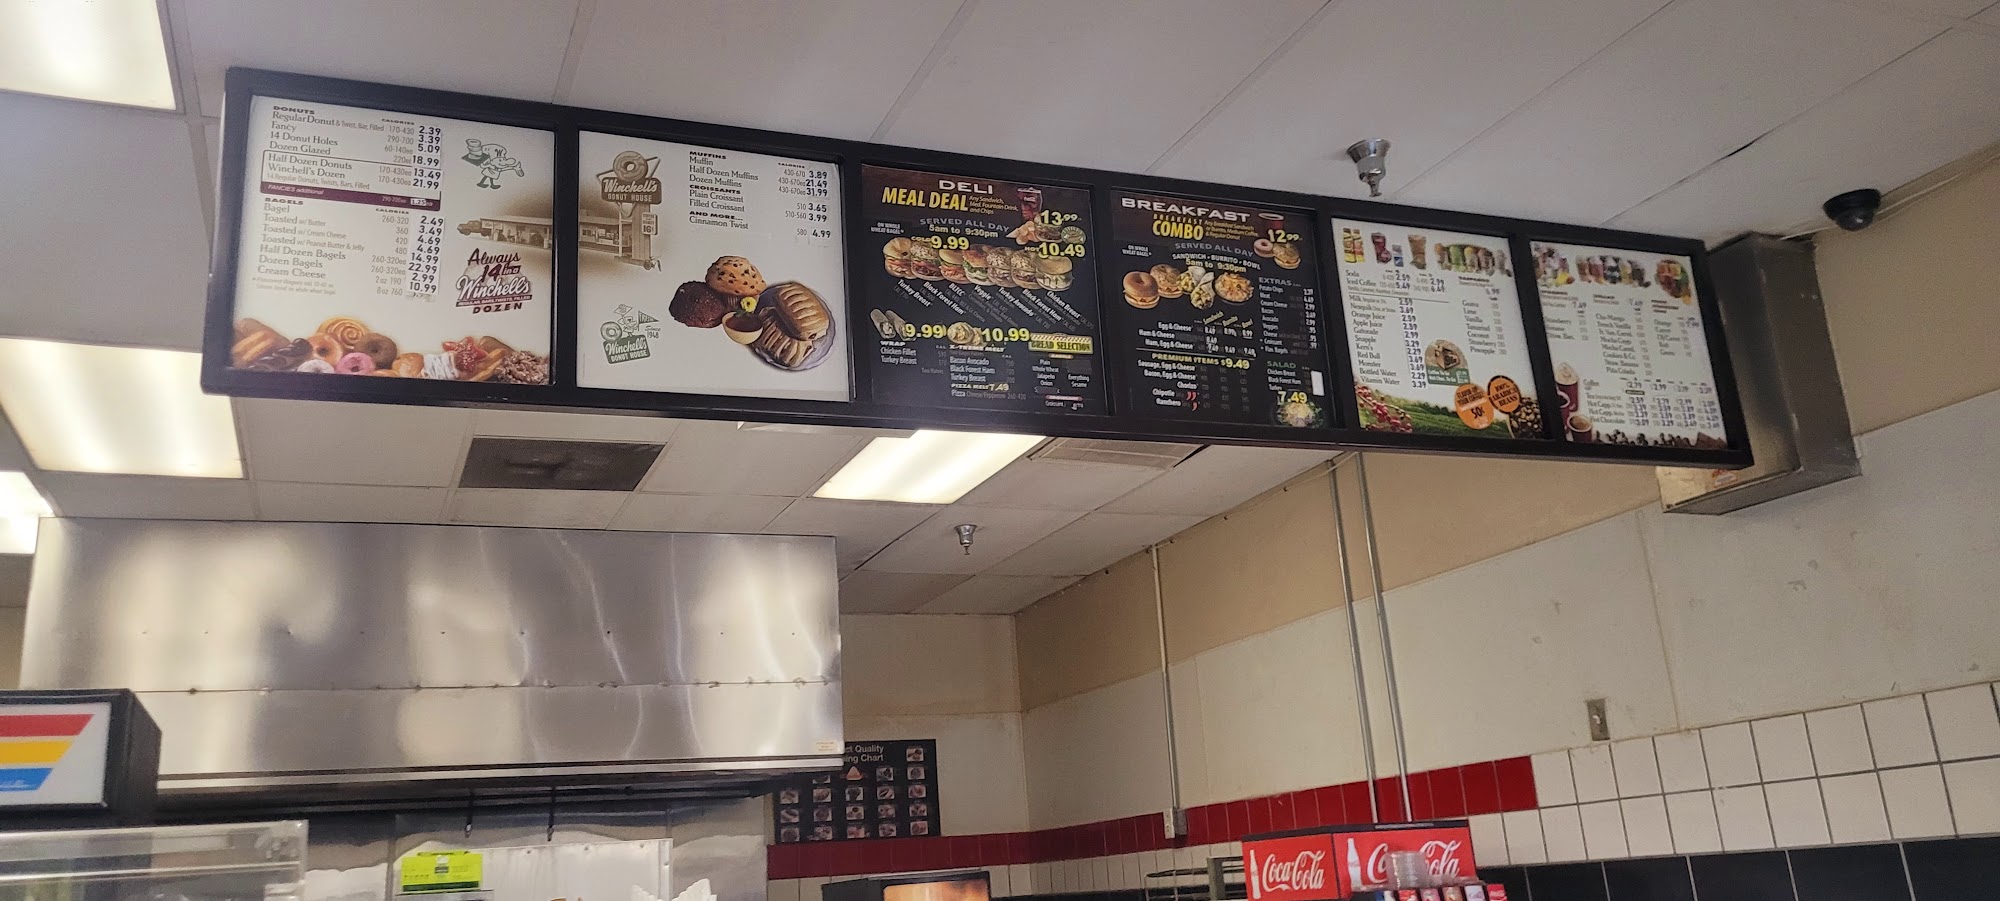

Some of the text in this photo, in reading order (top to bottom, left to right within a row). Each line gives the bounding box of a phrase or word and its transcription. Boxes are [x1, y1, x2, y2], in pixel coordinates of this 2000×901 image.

[273, 106, 315, 114] DONUTS
[272, 121, 440, 144] Fancy 3.39
[419, 126, 441, 135] 2.39
[270, 131, 440, 153] 14 Donut Holes 5.09
[270, 142, 439, 166] Dozen Glazed 18.99
[690, 151, 726, 159] MUFFINS
[269, 153, 441, 179] Half Dozen Donuts 13.49
[690, 156, 827, 179] Muffin 3.89
[268, 163, 439, 190] Winchell's Dozen 21.99
[690, 165, 827, 188] Half Dozen Muffins 21.49
[603, 179, 658, 193] Winchell's
[690, 174, 828, 196] Dozen Muffins 31.99
[690, 184, 741, 194] CROISSANTS
[939, 180, 993, 194] DELI
[690, 190, 709, 198] Plain
[710, 192, 744, 202] Croissant
[808, 203, 827, 212] 3.65
[882, 187, 968, 211] MEAL DEAL
[264, 203, 444, 226] Bagel 2.49
[690, 199, 827, 222] Filled Croissant 3.99
[1122, 198, 1250, 222] BREAKFAST
[264, 213, 442, 236] Toasted 3.49
[1154, 214, 1203, 224] BREAKFAST
[690, 216, 831, 238] Cinnamon Twist 4.99
[929, 225, 948, 233] 5am
[965, 228, 998, 238] 9:30pm
[988, 223, 1009, 232] DAY
[1152, 220, 1204, 240] COMBO
[263, 224, 440, 245] Toasted 4.69
[262, 234, 440, 254] Toasted 4.69
[931, 235, 969, 250] 9.99
[1040, 242, 1085, 257] 10.49
[1175, 242, 1212, 250] SERVED
[1235, 249, 1254, 257] DAY
[260, 244, 439, 264] Half Dozen Bagels 14.99
[468, 248, 521, 266] Always
[259, 255, 437, 274] Dozen Bagels 22.99
[1186, 259, 1246, 272] 5am to 9:30pm
[1211, 255, 1238, 264] BURRITO
[1243, 260, 1261, 270] BOWL
[258, 266, 435, 283] Cream Cheese 2.99
[481, 264, 502, 282] 14
[409, 282, 437, 293] 10.99
[456, 275, 530, 299] Winchell's
[1259, 277, 1292, 286] EXTRAS
[923, 281, 938, 294] Black
[937, 291, 953, 307] Forest
[1047, 291, 1066, 307] Chicken
[473, 303, 522, 314] DOZEN
[1350, 303, 1372, 311] Nesquik
[1351, 311, 1371, 319] Orange
[1158, 322, 1168, 330] Egg
[1353, 319, 1368, 327] Apple
[905, 324, 943, 338] 9.99
[981, 328, 1030, 342] 10.99
[1031, 341, 1091, 350] BREAD SELECTION
[1160, 341, 1169, 349] Egg
[1355, 335, 1376, 345] Snapple
[1356, 343, 1373, 351] Kern's
[1469, 339, 1496, 347] Strawberry
[1470, 346, 1495, 355] Pineapple
[881, 356, 899, 365] Turkey
[949, 356, 966, 364] Bacon
[1152, 353, 1219, 365] PREMIUM ITEMS
[1162, 362, 1196, 371] Egg Cheese
[951, 374, 968, 382] Turkey
[1162, 371, 1172, 379] Egg
[1361, 376, 1382, 384] Vitamin
[1278, 391, 1307, 403] 7.49
[1499, 396, 1518, 406] BEANS
[855, 745, 884, 754] Quality
[1262, 850, 1325, 892] Coca-Cola
